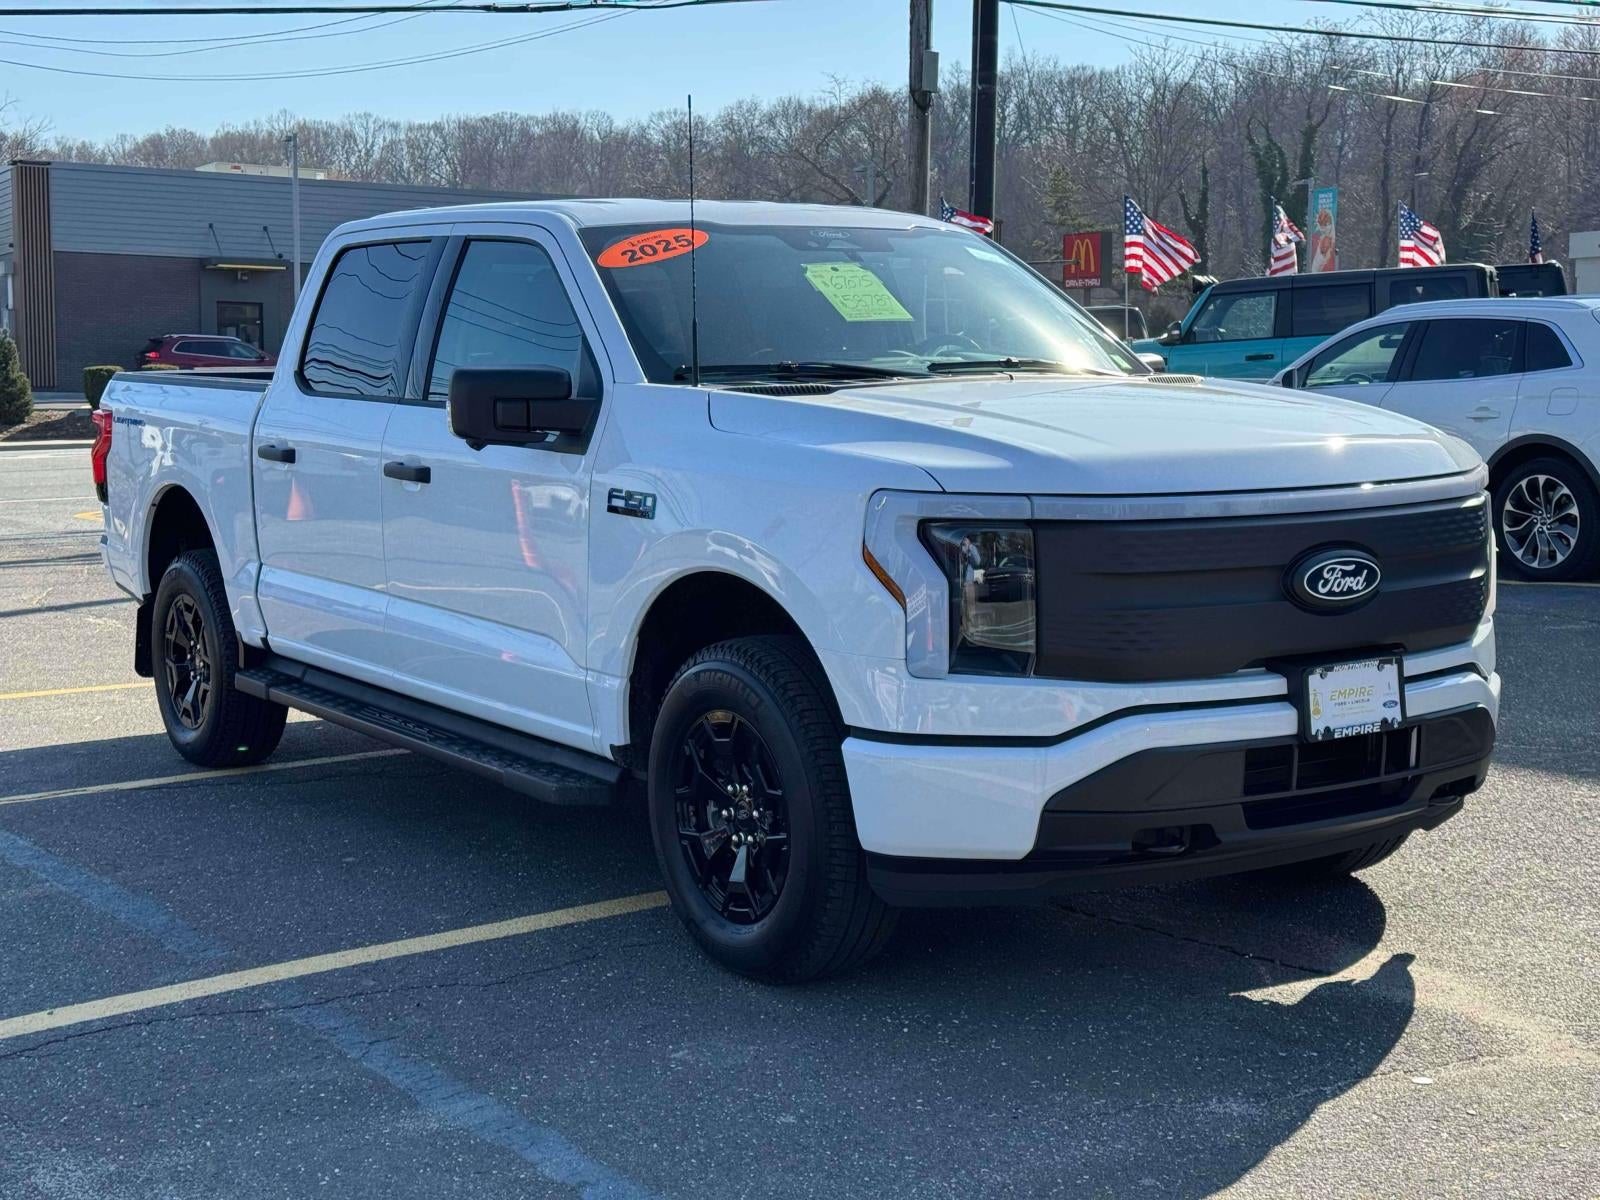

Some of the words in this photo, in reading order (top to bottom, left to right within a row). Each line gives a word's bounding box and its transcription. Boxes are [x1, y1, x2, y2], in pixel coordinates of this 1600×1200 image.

[620, 234, 693, 263] 2025
[1318, 564, 1368, 594] Ford
[1329, 685, 1375, 701] EMPIRE
[1334, 722, 1382, 739] EMPIRE
